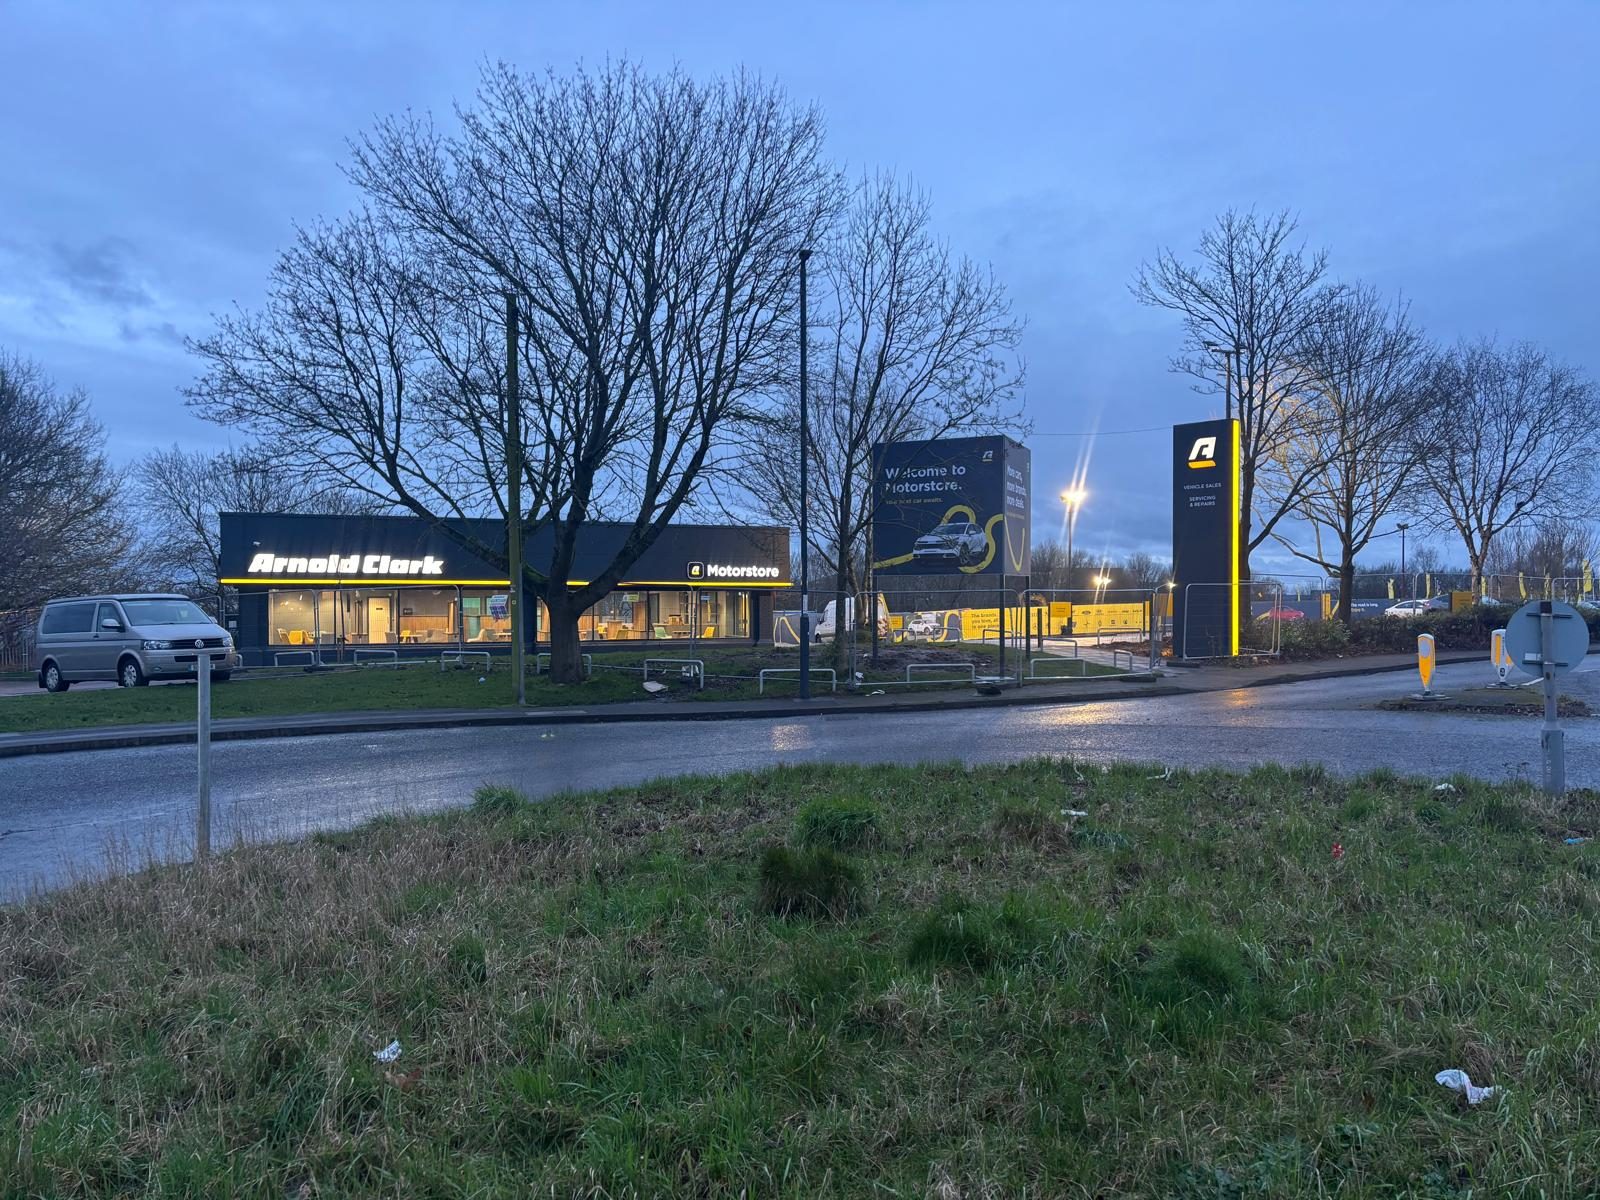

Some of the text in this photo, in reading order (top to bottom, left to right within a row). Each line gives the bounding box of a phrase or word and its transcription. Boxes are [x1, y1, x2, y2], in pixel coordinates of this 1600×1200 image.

[885, 464, 966, 479] Welcome to
[885, 480, 962, 493] Motorstore.
[248, 553, 445, 574] Arnold Clark
[707, 564, 780, 577] Motorstore
